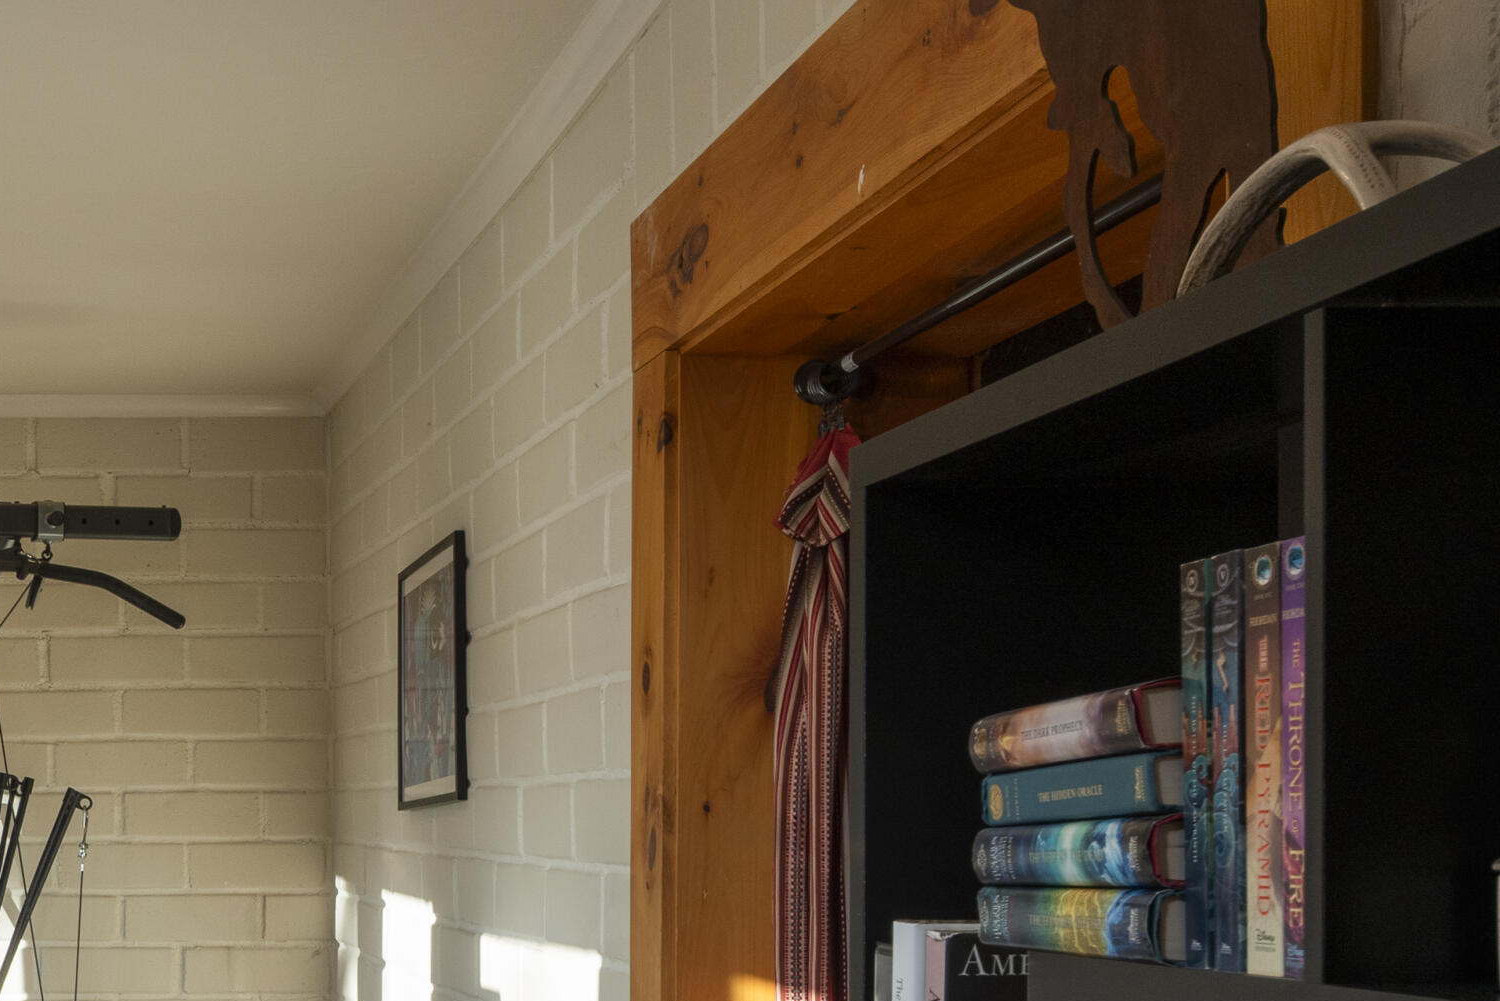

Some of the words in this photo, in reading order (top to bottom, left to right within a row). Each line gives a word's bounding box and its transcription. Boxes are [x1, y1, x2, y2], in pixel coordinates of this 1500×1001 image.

[1291, 638, 1302, 669] THE
[1050, 720, 1083, 737] PROPHECY
[1254, 675, 1273, 752] RED
[1287, 672, 1305, 812] THRONE
[1077, 784, 1104, 799] ORACLE
[1256, 763, 1273, 918] PYRAMID
[1288, 848, 1305, 929] FIRE
[895, 977, 904, 1001] The
